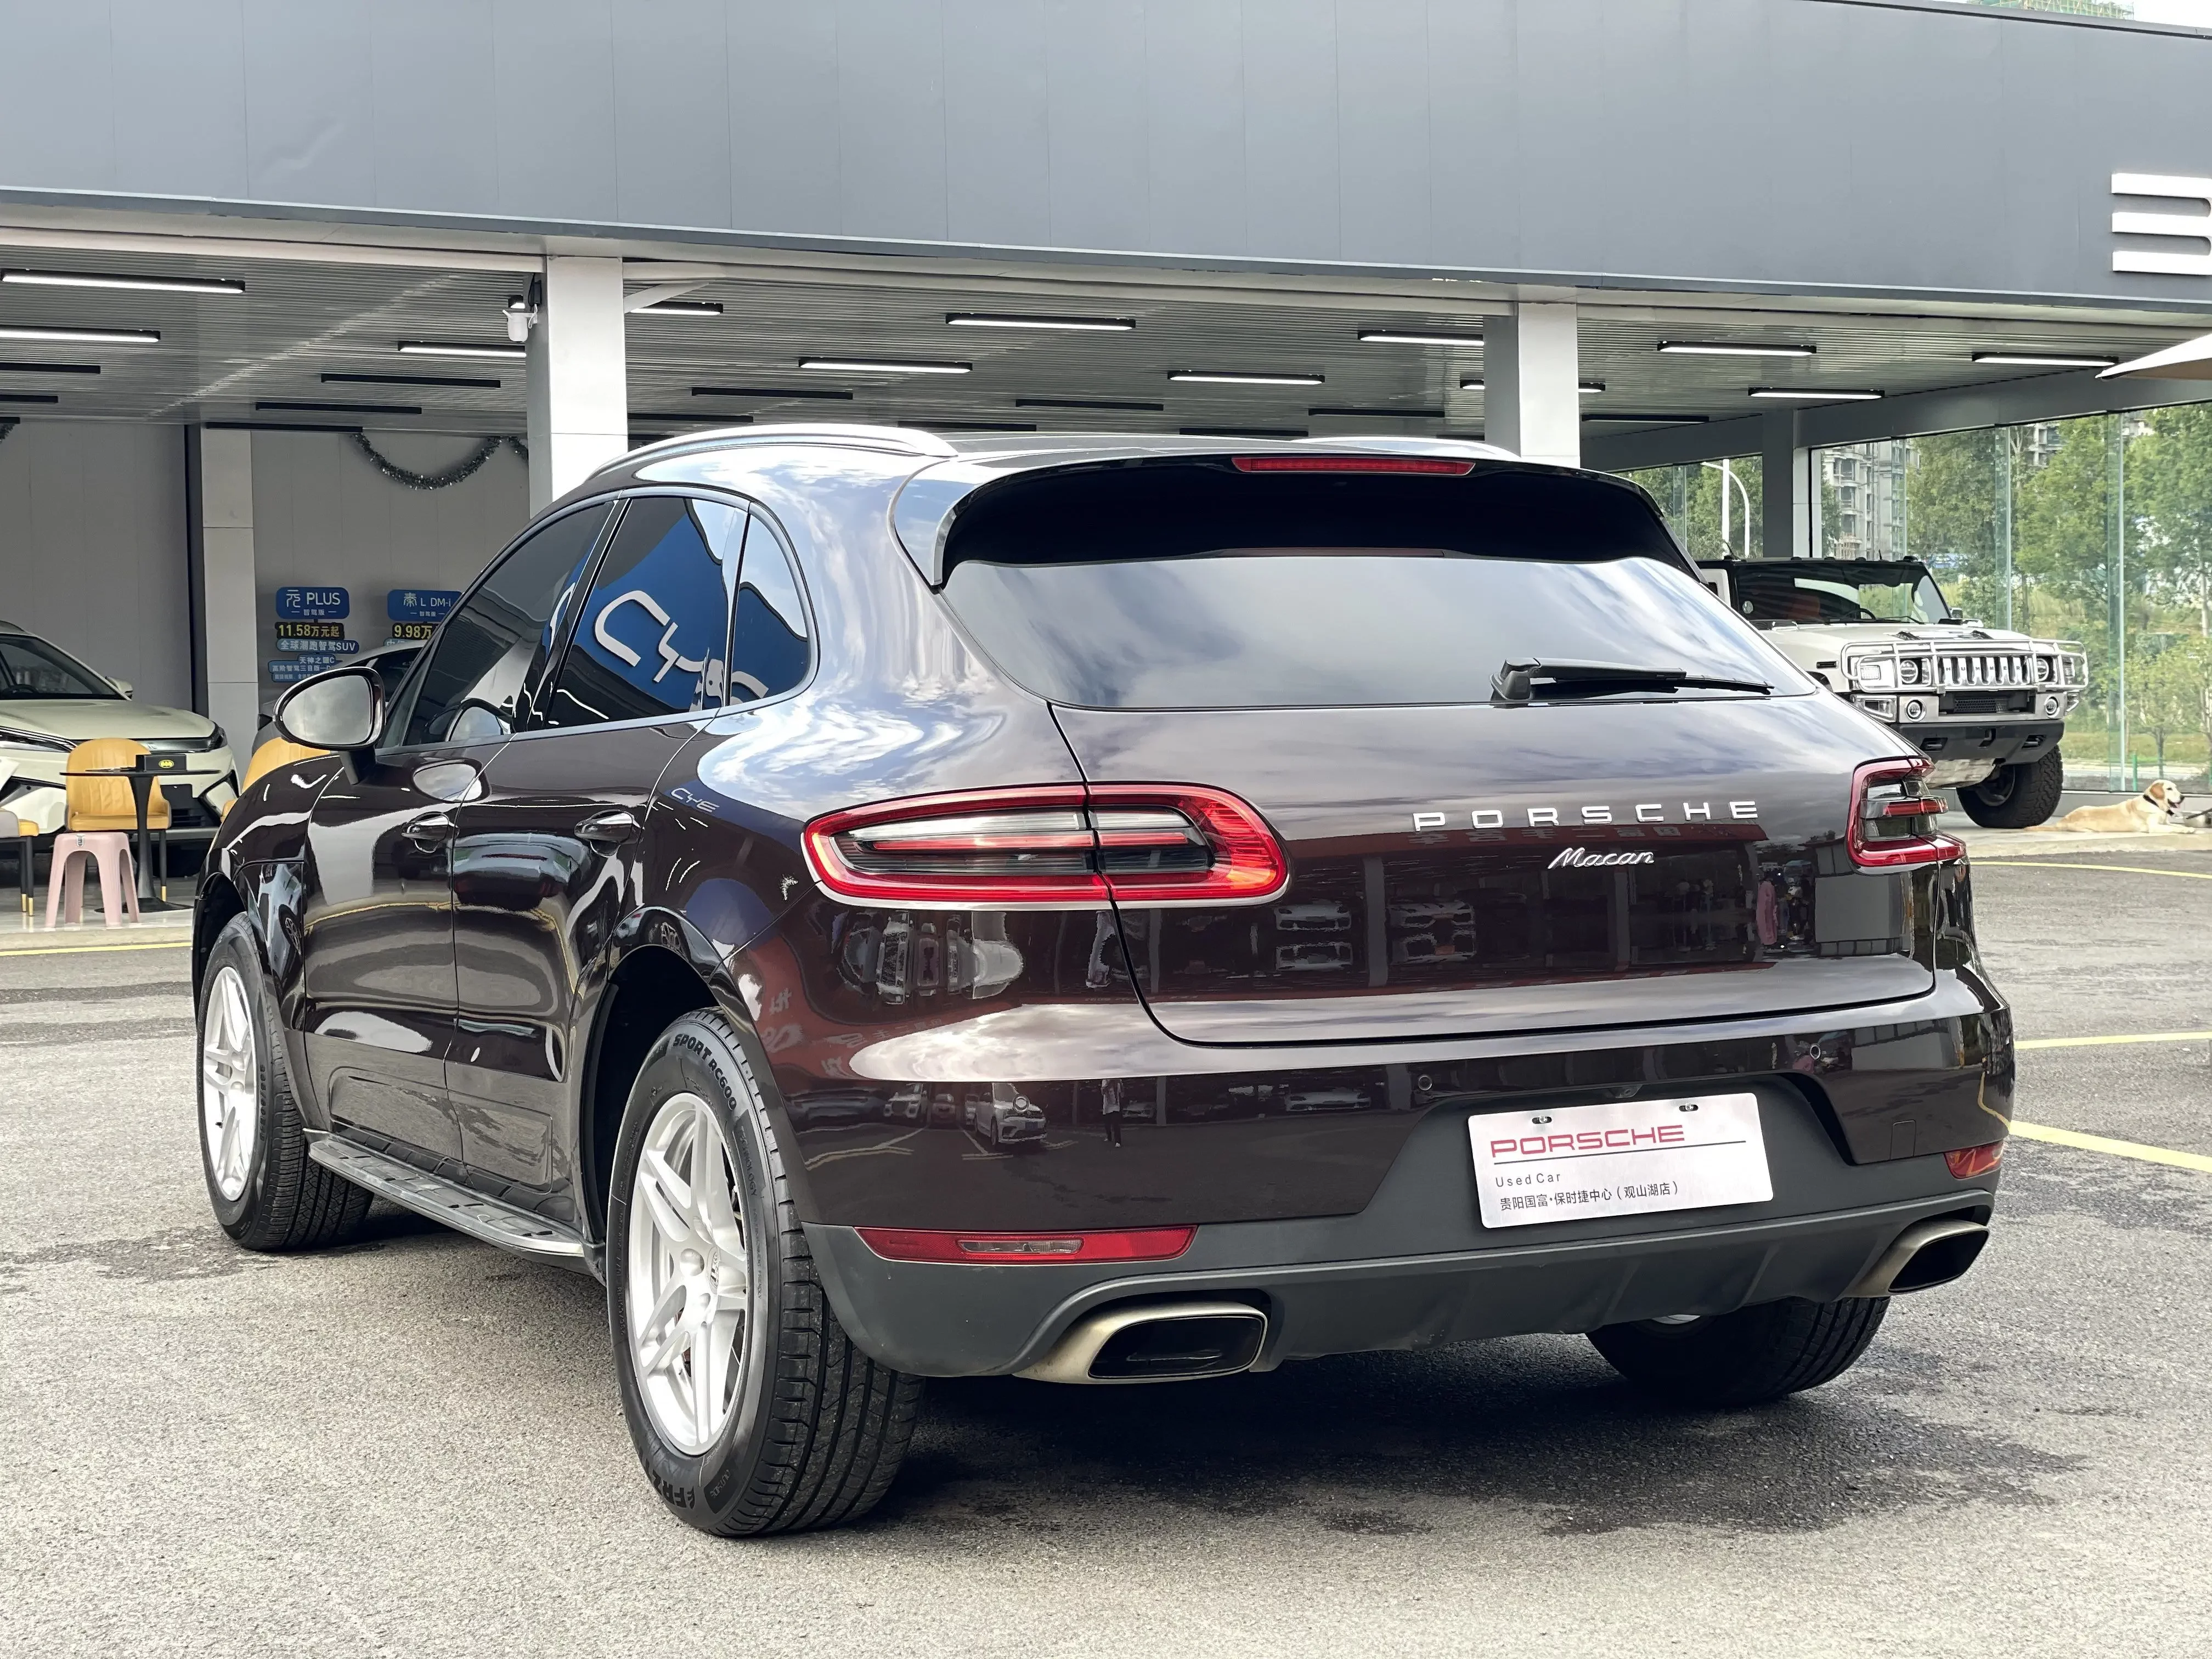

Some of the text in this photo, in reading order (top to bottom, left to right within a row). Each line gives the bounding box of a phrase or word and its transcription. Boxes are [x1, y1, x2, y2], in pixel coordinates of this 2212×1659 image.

[306, 592, 341, 606] PLUS
[420, 597, 427, 607] L
[430, 597, 452, 607] DM-i
[278, 624, 340, 638] 11.58万元起
[394, 624, 437, 641] 9.98万
[1413, 800, 1759, 832] PORSCHE
[1548, 847, 1655, 870] Macan
[673, 1033, 712, 1062] SPORT
[708, 1058, 737, 1111] RC600
[1490, 1125, 1685, 1158] PORSCHE
[1496, 1172, 1561, 1188] Used Car
